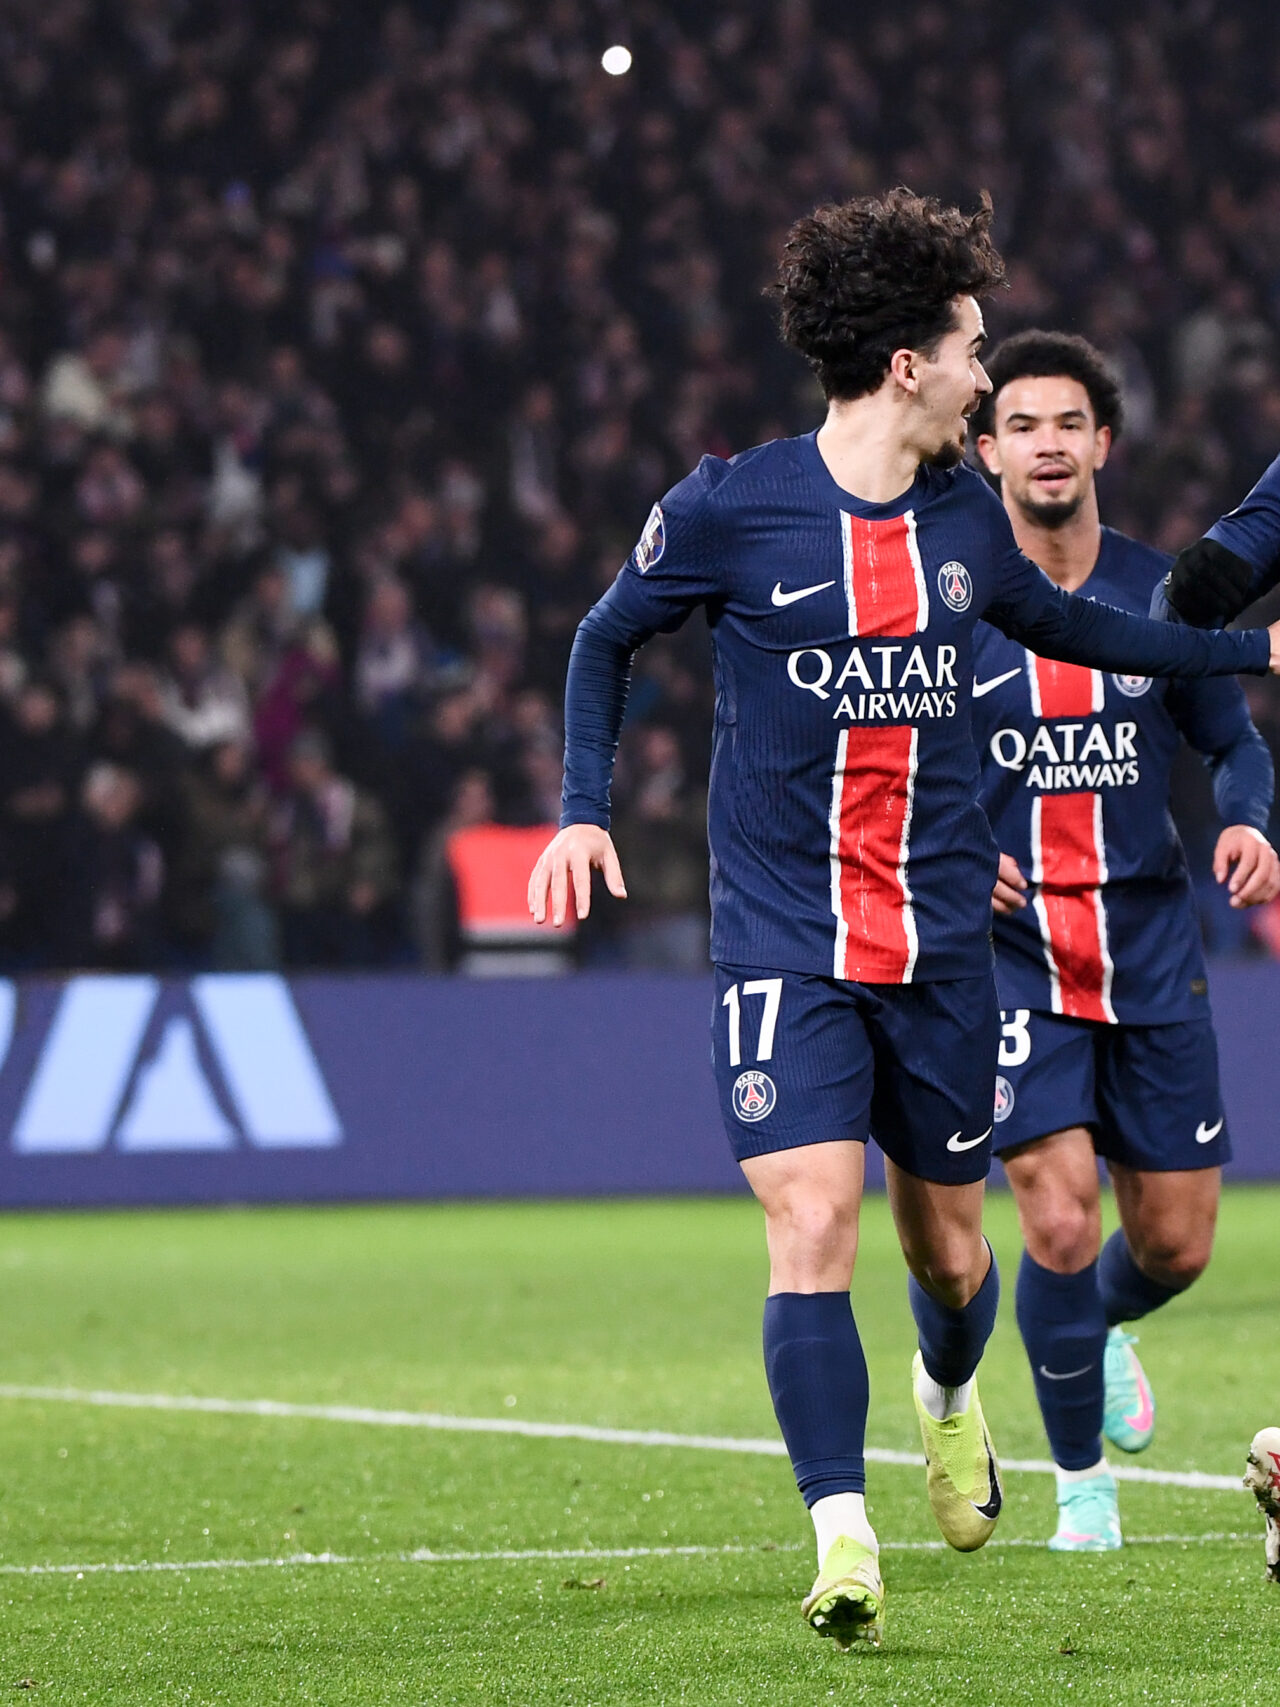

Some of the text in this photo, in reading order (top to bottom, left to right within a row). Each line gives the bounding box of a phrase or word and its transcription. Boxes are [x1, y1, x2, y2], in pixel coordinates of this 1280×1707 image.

[942, 563, 965, 577] PARIS
[786, 644, 959, 700] QATAR
[832, 692, 956, 720] AIRWAYS
[990, 721, 1138, 770] QATAR
[1026, 760, 1140, 790] AIRWAYS
[722, 977, 783, 1067] 17
[736, 1073, 765, 1089] PARIS
